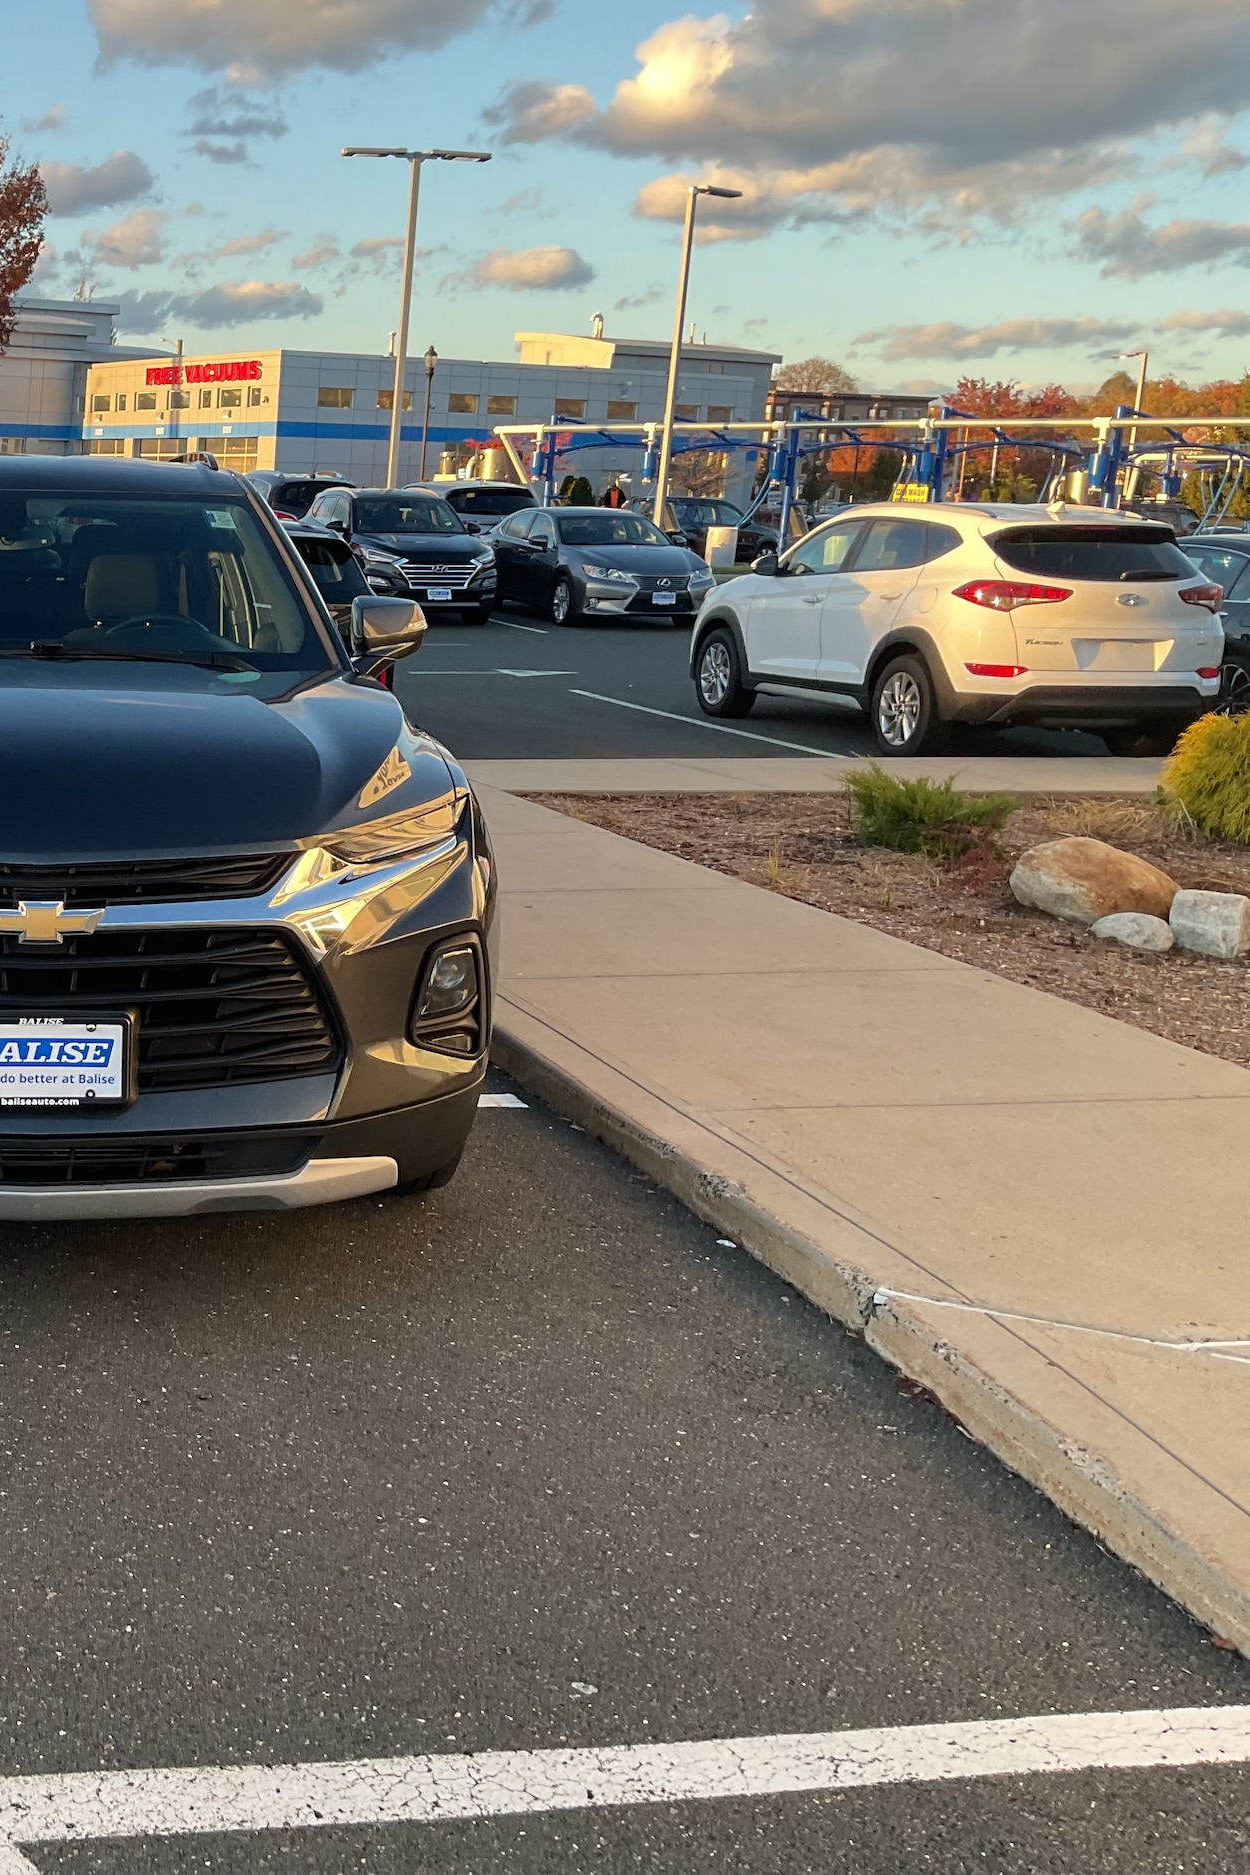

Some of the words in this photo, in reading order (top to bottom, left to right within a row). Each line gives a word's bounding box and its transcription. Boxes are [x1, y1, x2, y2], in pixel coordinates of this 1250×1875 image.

[146, 367, 183, 385] FREE
[185, 360, 262, 383] VACUUMS
[18, 1017, 65, 1025] BALISE
[0, 1073, 15, 1084] do
[19, 1073, 58, 1084] better
[62, 1074, 75, 1084] at
[79, 1074, 115, 1084] Balise
[0, 1097, 80, 1106] baliseauto.com
